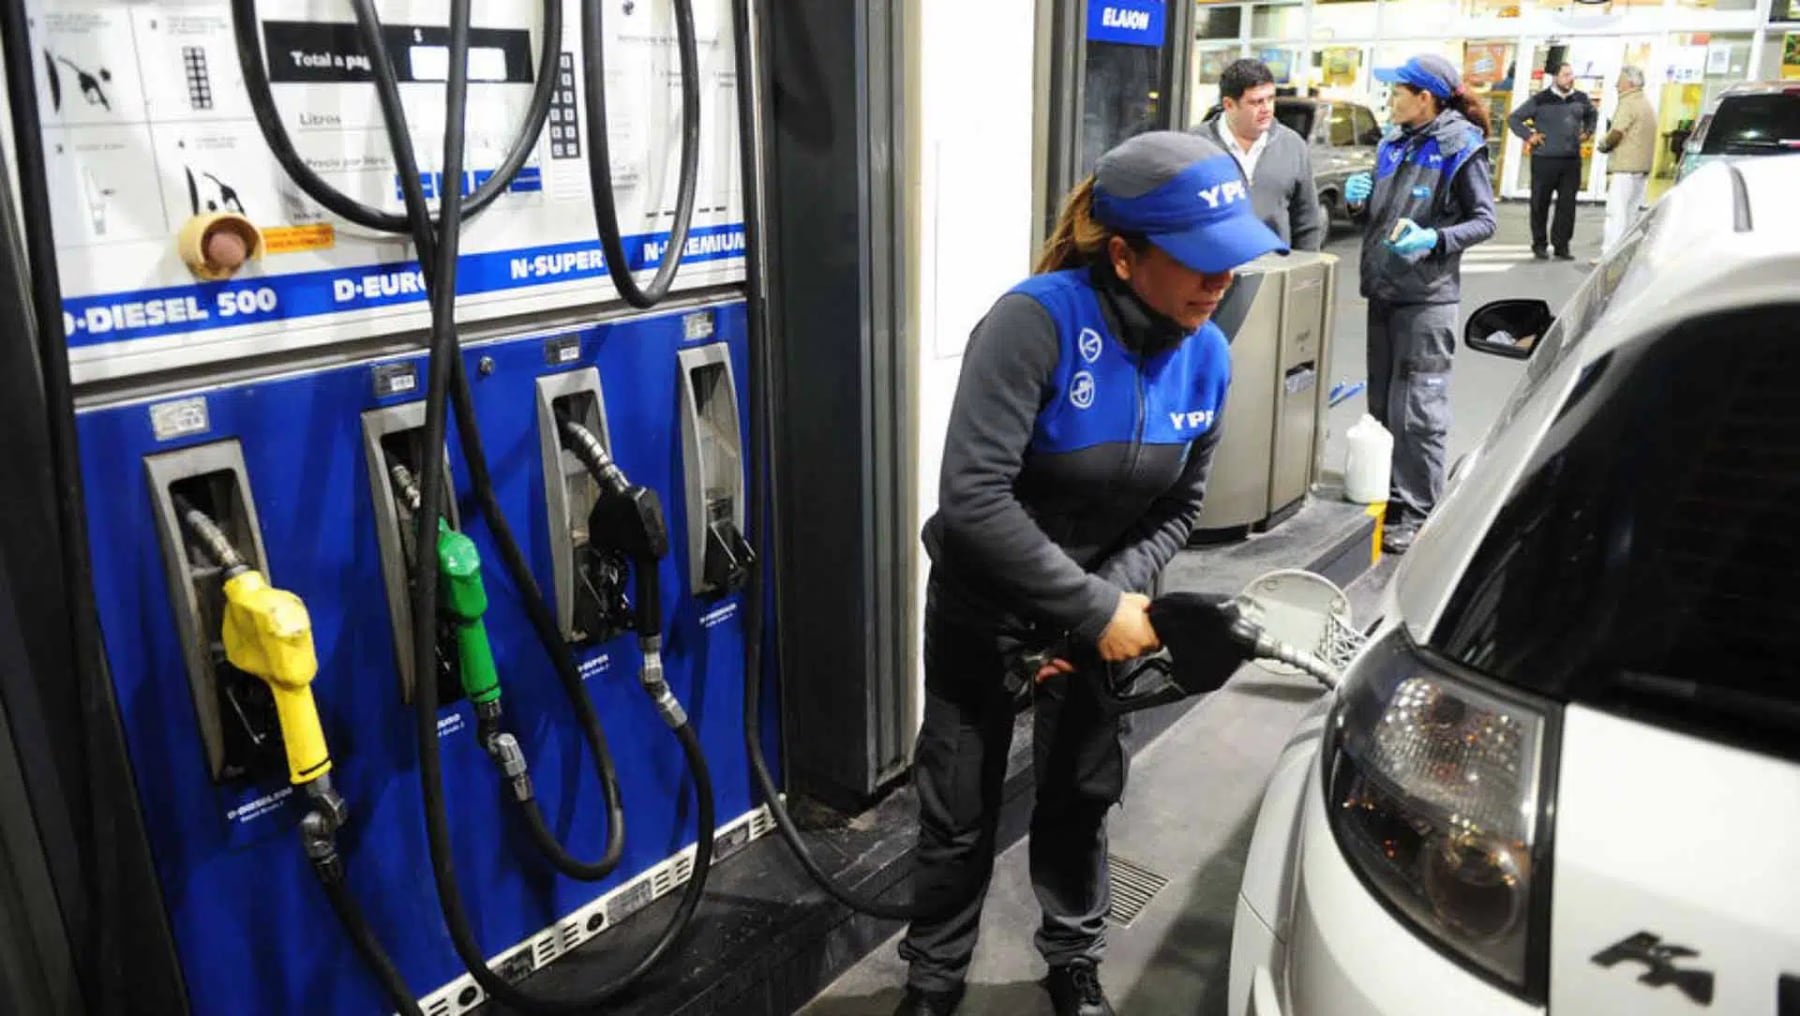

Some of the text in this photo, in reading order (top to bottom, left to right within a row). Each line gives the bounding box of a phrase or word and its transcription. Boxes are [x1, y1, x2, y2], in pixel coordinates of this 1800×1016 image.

[290, 51, 332, 67] Total
[334, 56, 345, 67] a
[299, 113, 342, 126] Litros
[216, 288, 277, 317] 500
